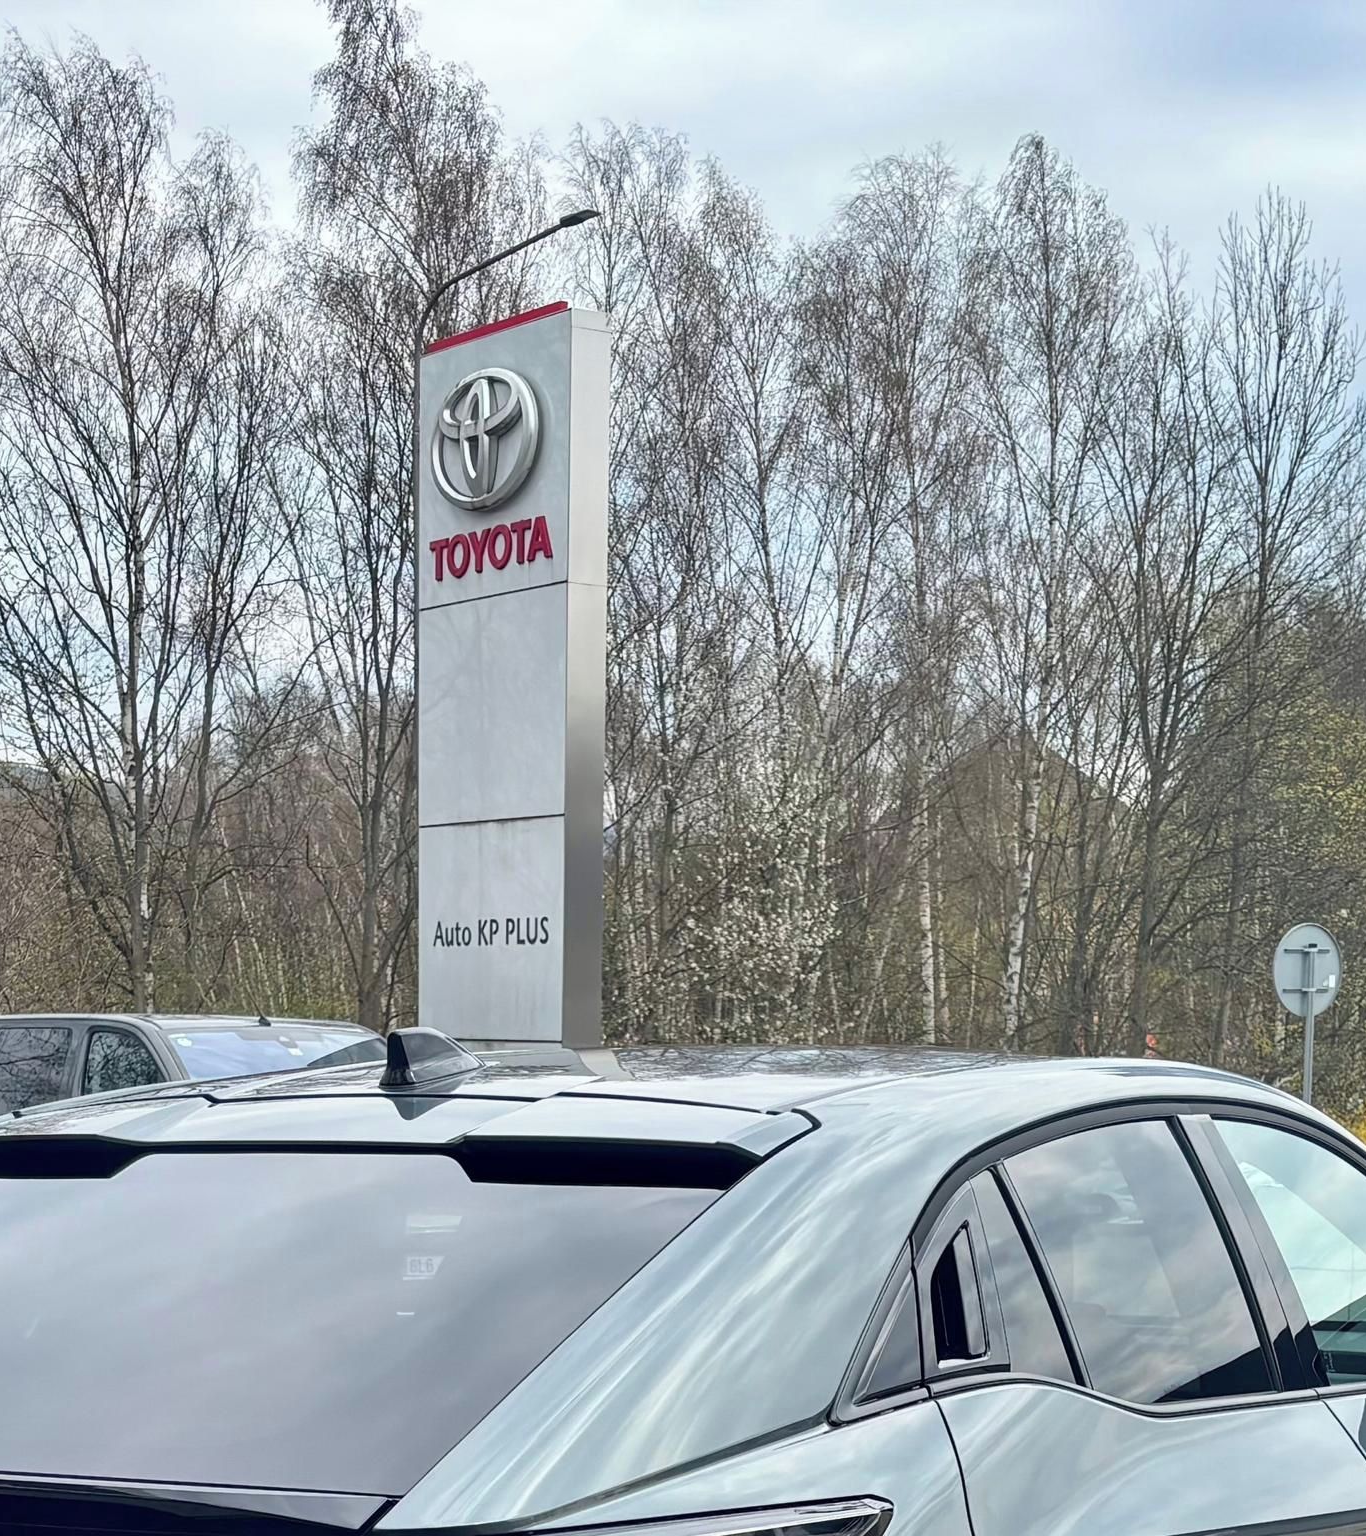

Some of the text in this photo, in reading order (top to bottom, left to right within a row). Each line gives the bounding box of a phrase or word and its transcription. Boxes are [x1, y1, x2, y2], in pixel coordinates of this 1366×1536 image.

[430, 516, 553, 582] TOYOTA
[433, 917, 549, 947] Auto KP PLUS
